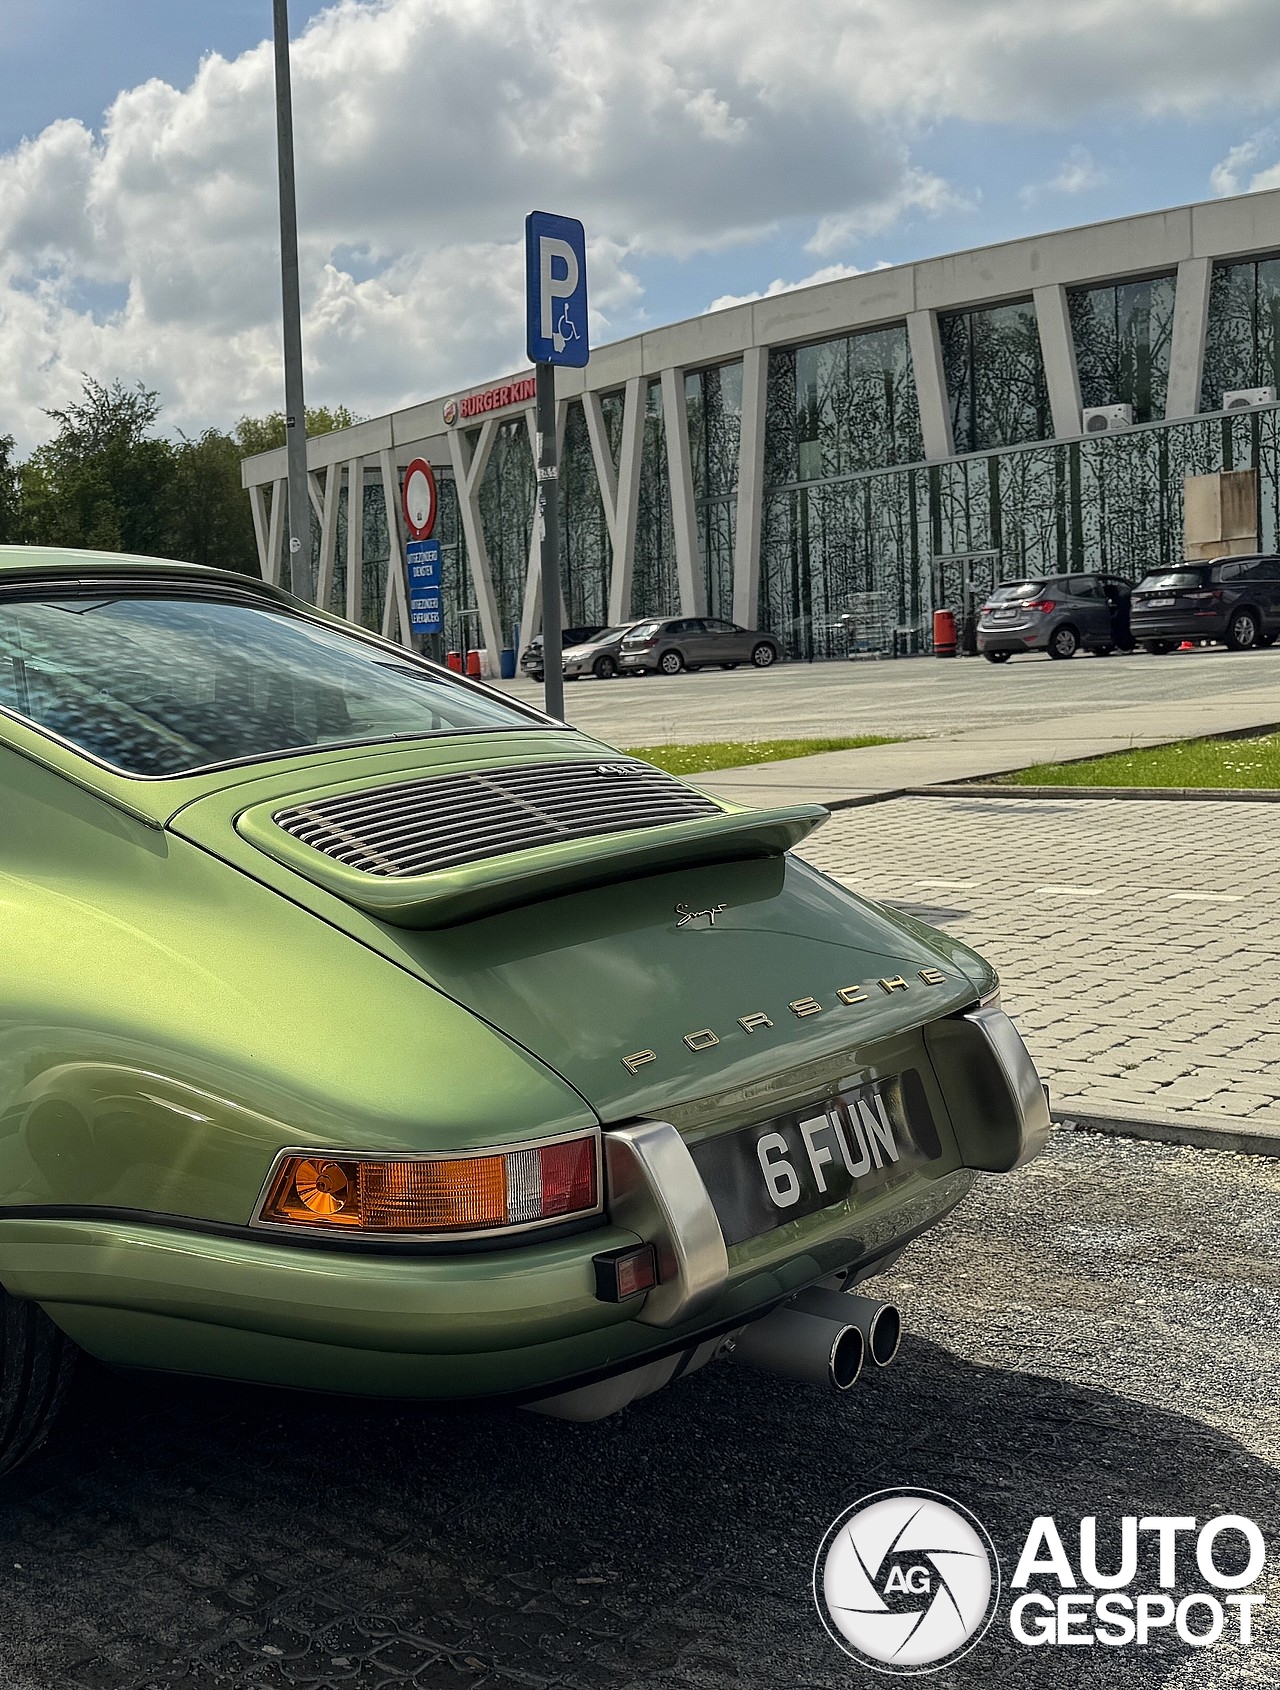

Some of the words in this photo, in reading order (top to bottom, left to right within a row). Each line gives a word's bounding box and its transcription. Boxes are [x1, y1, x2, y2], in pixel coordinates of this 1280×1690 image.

[540, 236, 579, 339] P
[460, 385, 511, 418] BURGER
[509, 378, 536, 402] KIN
[621, 967, 946, 1075] PORSCHE
[756, 1132, 801, 1208] 6
[799, 1094, 900, 1194] FUN
